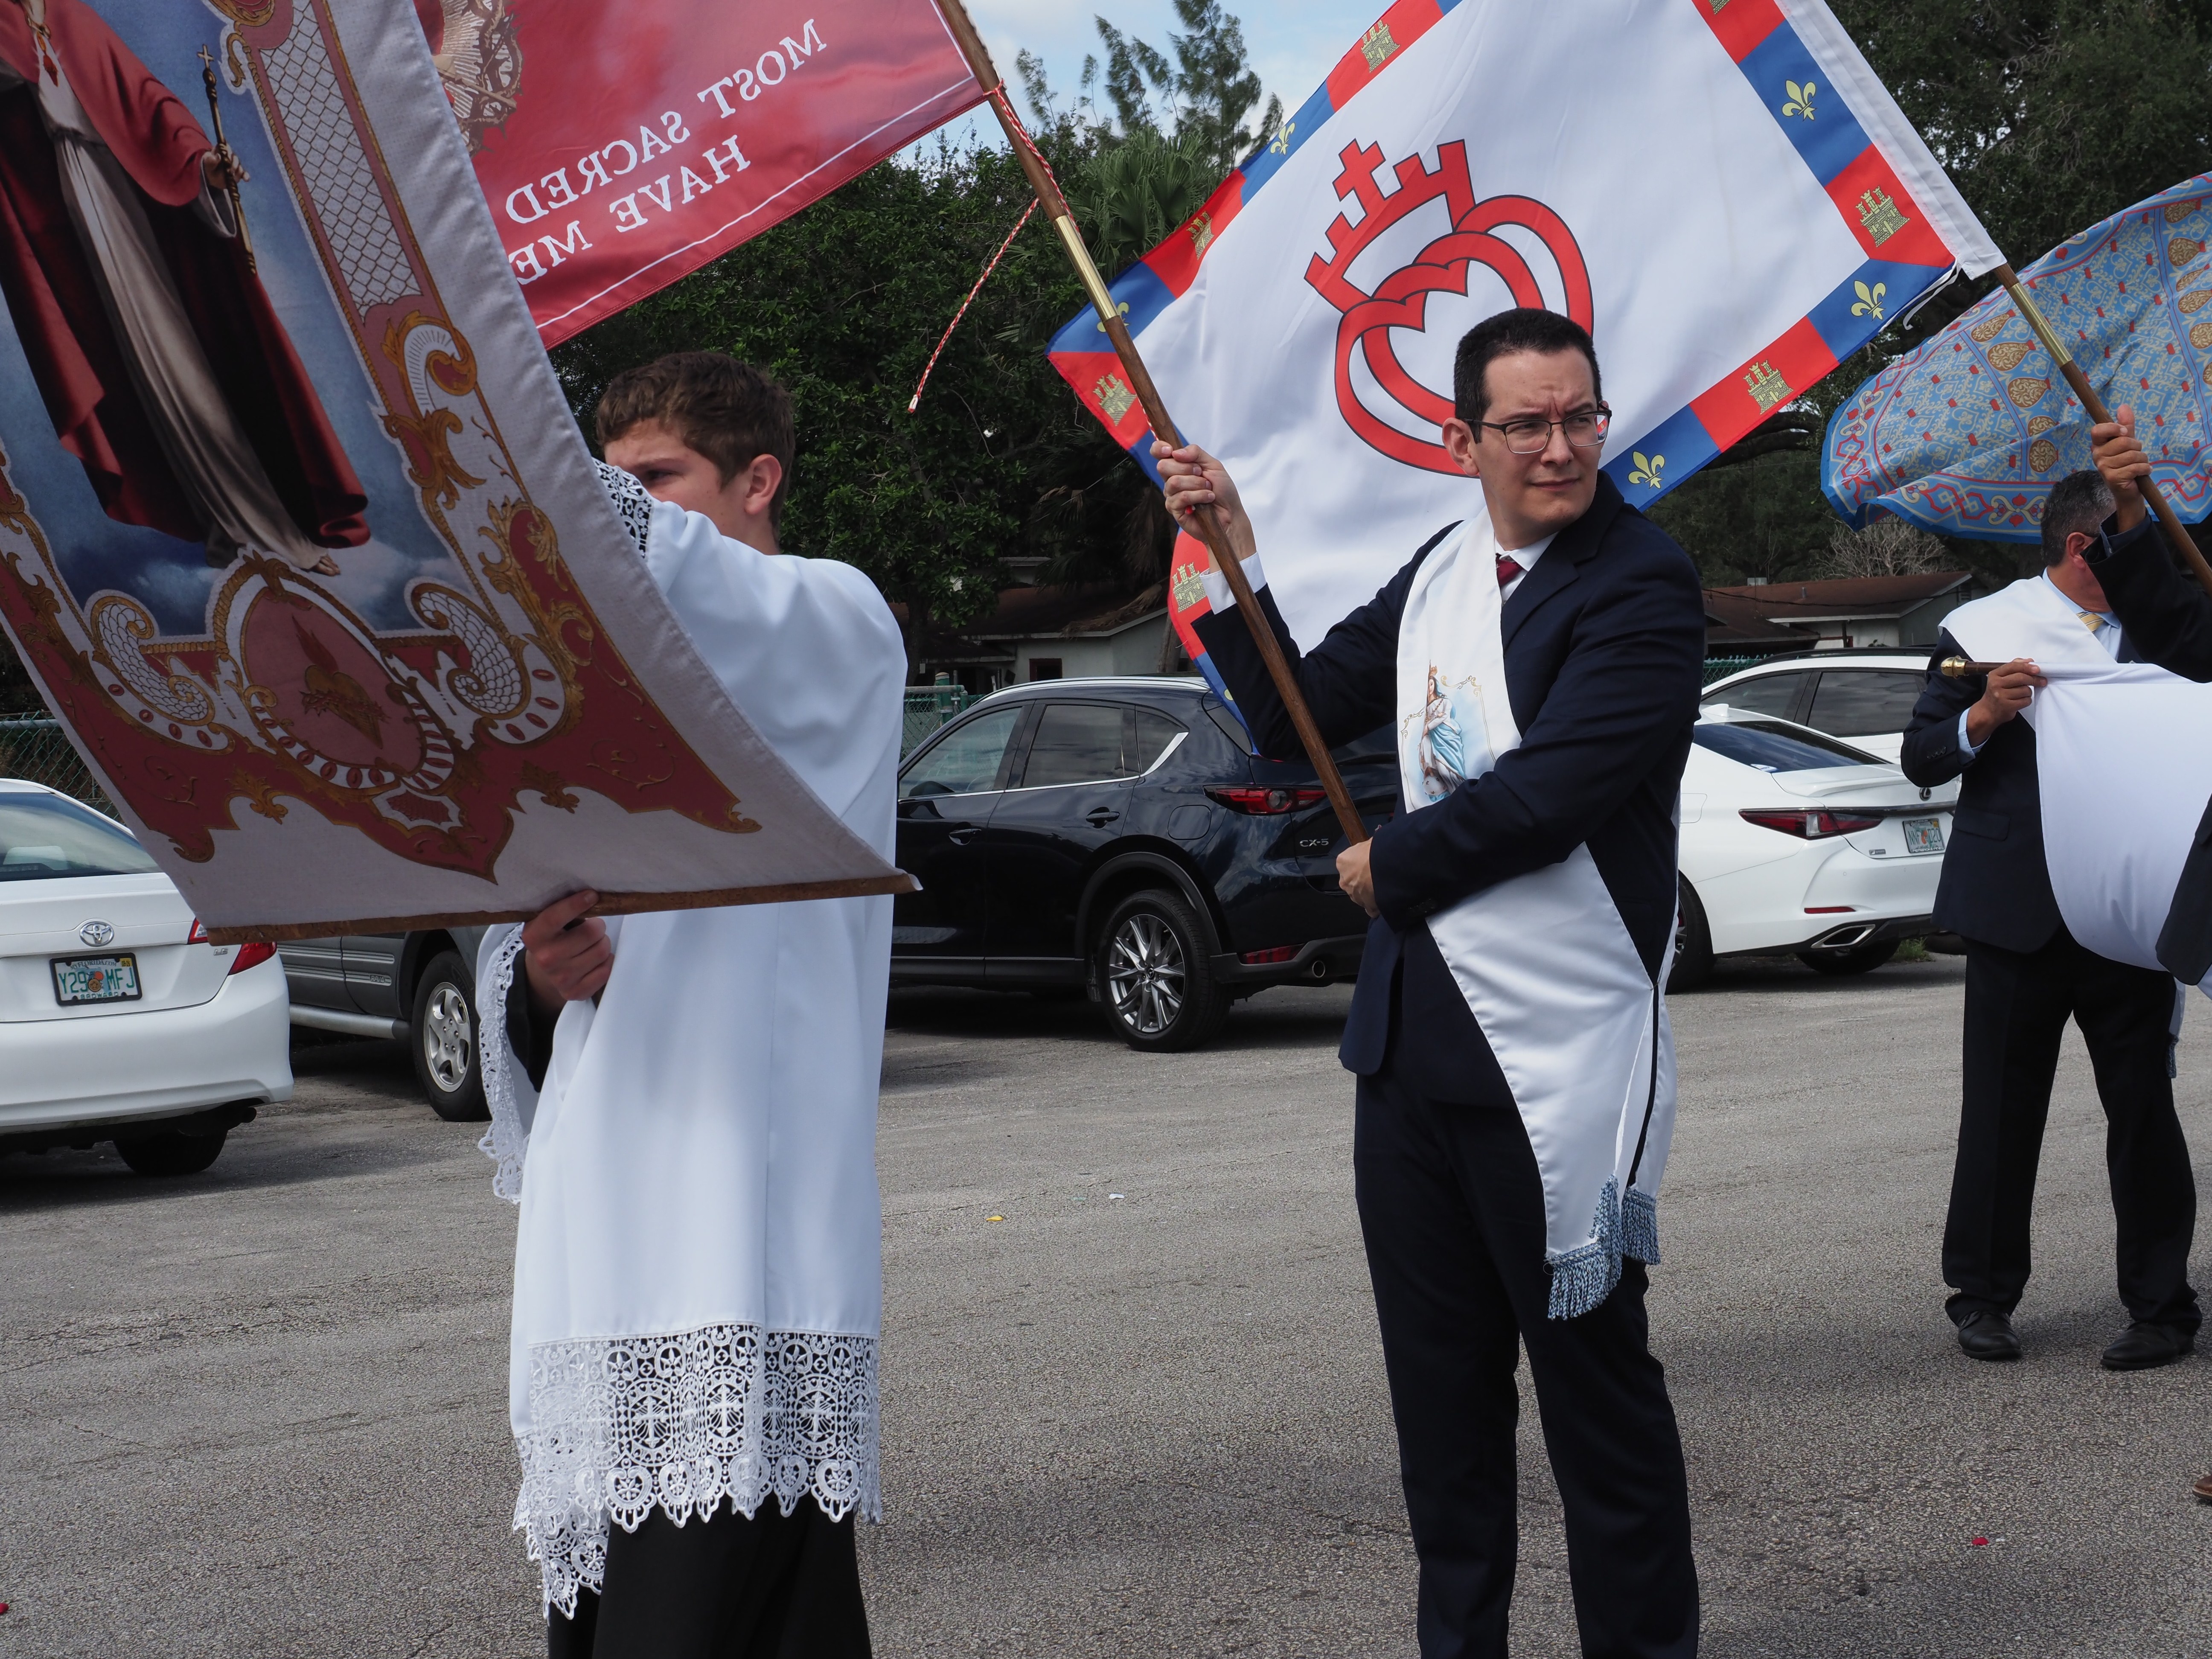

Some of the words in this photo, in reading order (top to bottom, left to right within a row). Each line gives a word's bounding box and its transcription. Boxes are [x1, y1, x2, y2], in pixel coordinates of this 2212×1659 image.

[1299, 838, 1329, 847] CX-5
[213, 947, 229, 956] LE
[58, 971, 89, 994] Y29
[105, 967, 135, 990] MFJ
